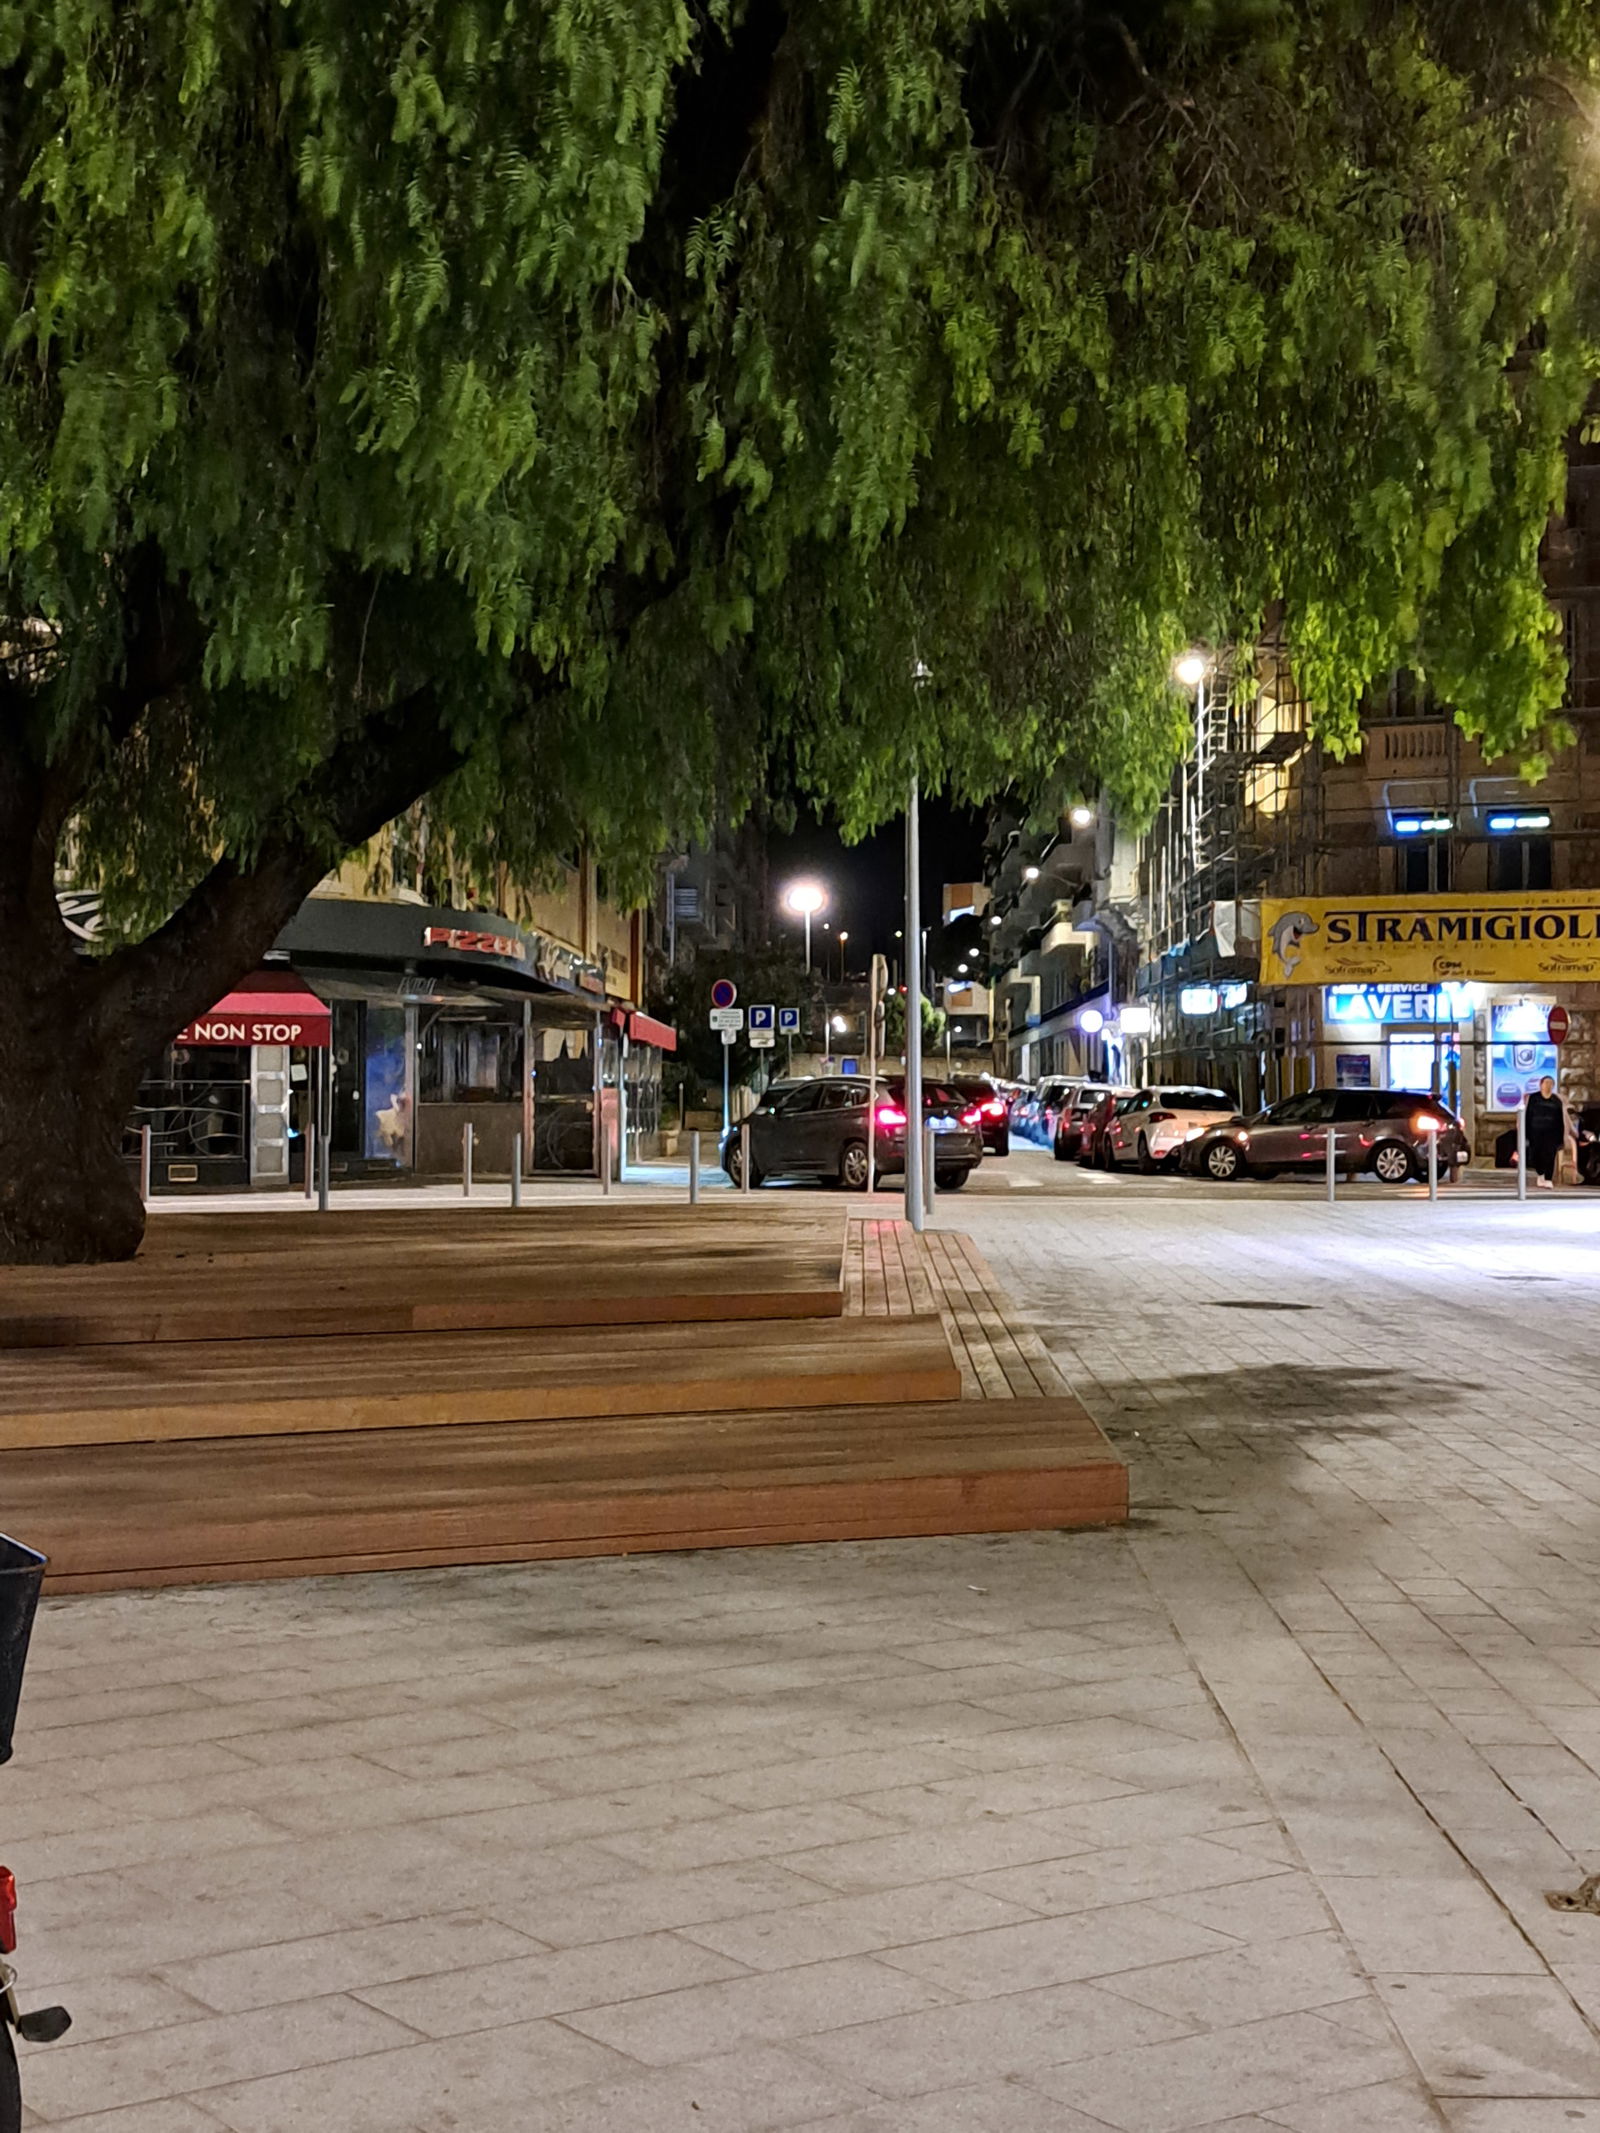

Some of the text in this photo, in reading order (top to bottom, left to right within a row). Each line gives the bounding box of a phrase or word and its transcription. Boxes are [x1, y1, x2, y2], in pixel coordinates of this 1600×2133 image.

[755, 1009, 767, 1026] P
[784, 1011, 794, 1024] P
[195, 1023, 245, 1040] NON
[252, 1024, 302, 1042] STOP
